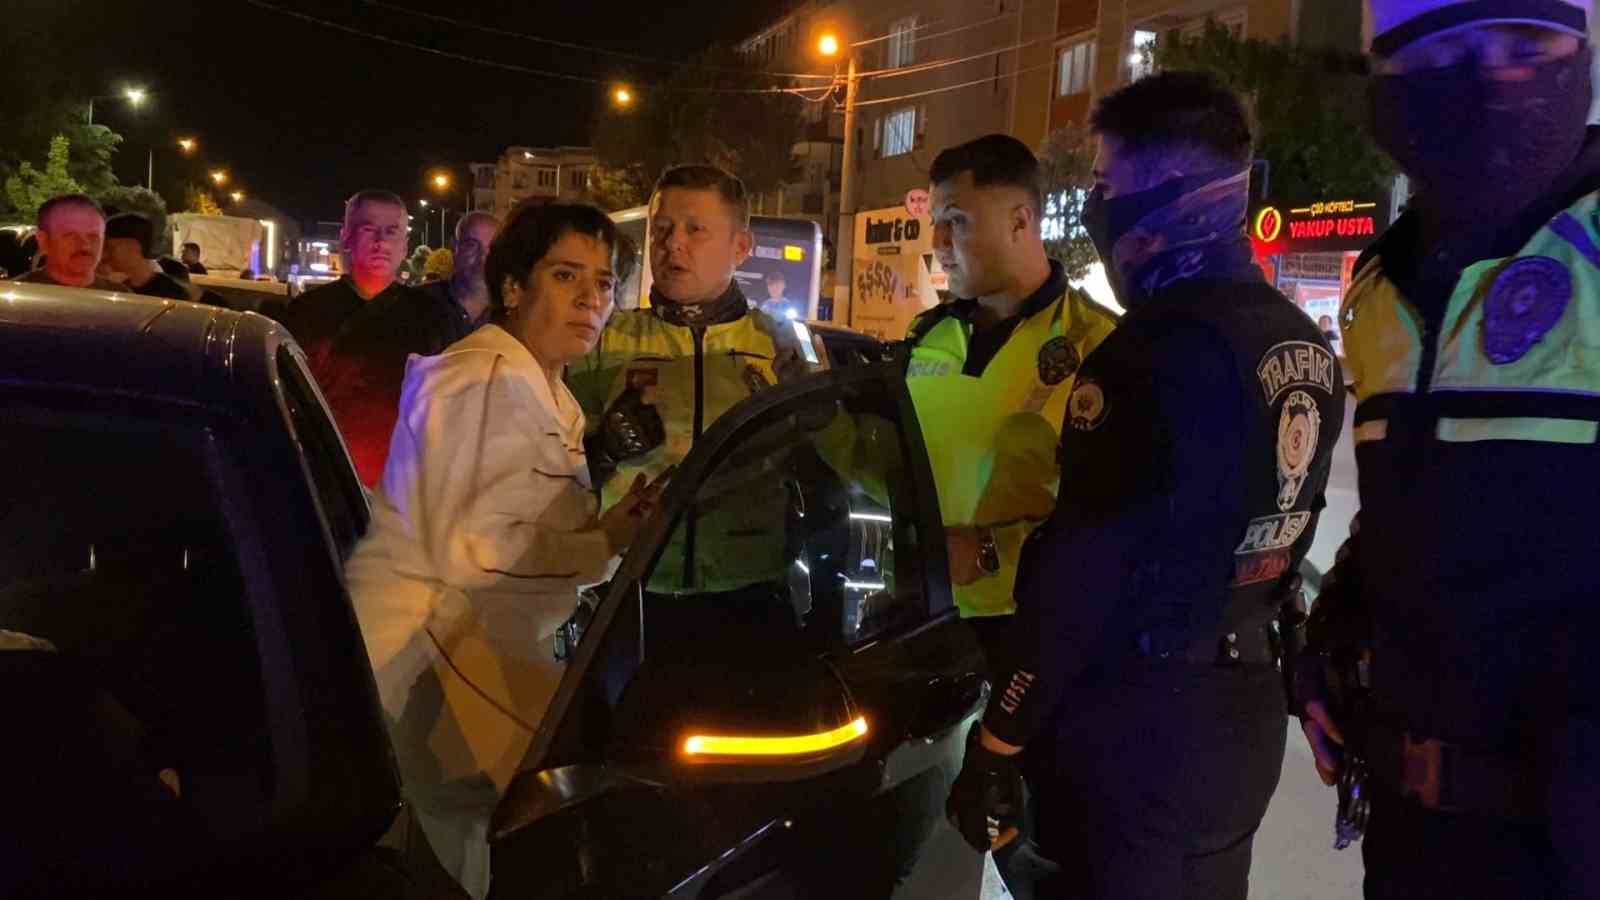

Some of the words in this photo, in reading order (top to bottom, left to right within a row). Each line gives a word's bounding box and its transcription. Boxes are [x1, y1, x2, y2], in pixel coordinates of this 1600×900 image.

[1290, 220, 1334, 238] YAKUP
[1337, 217, 1374, 235] USTA
[1000, 670, 1034, 714] KIPSTA
